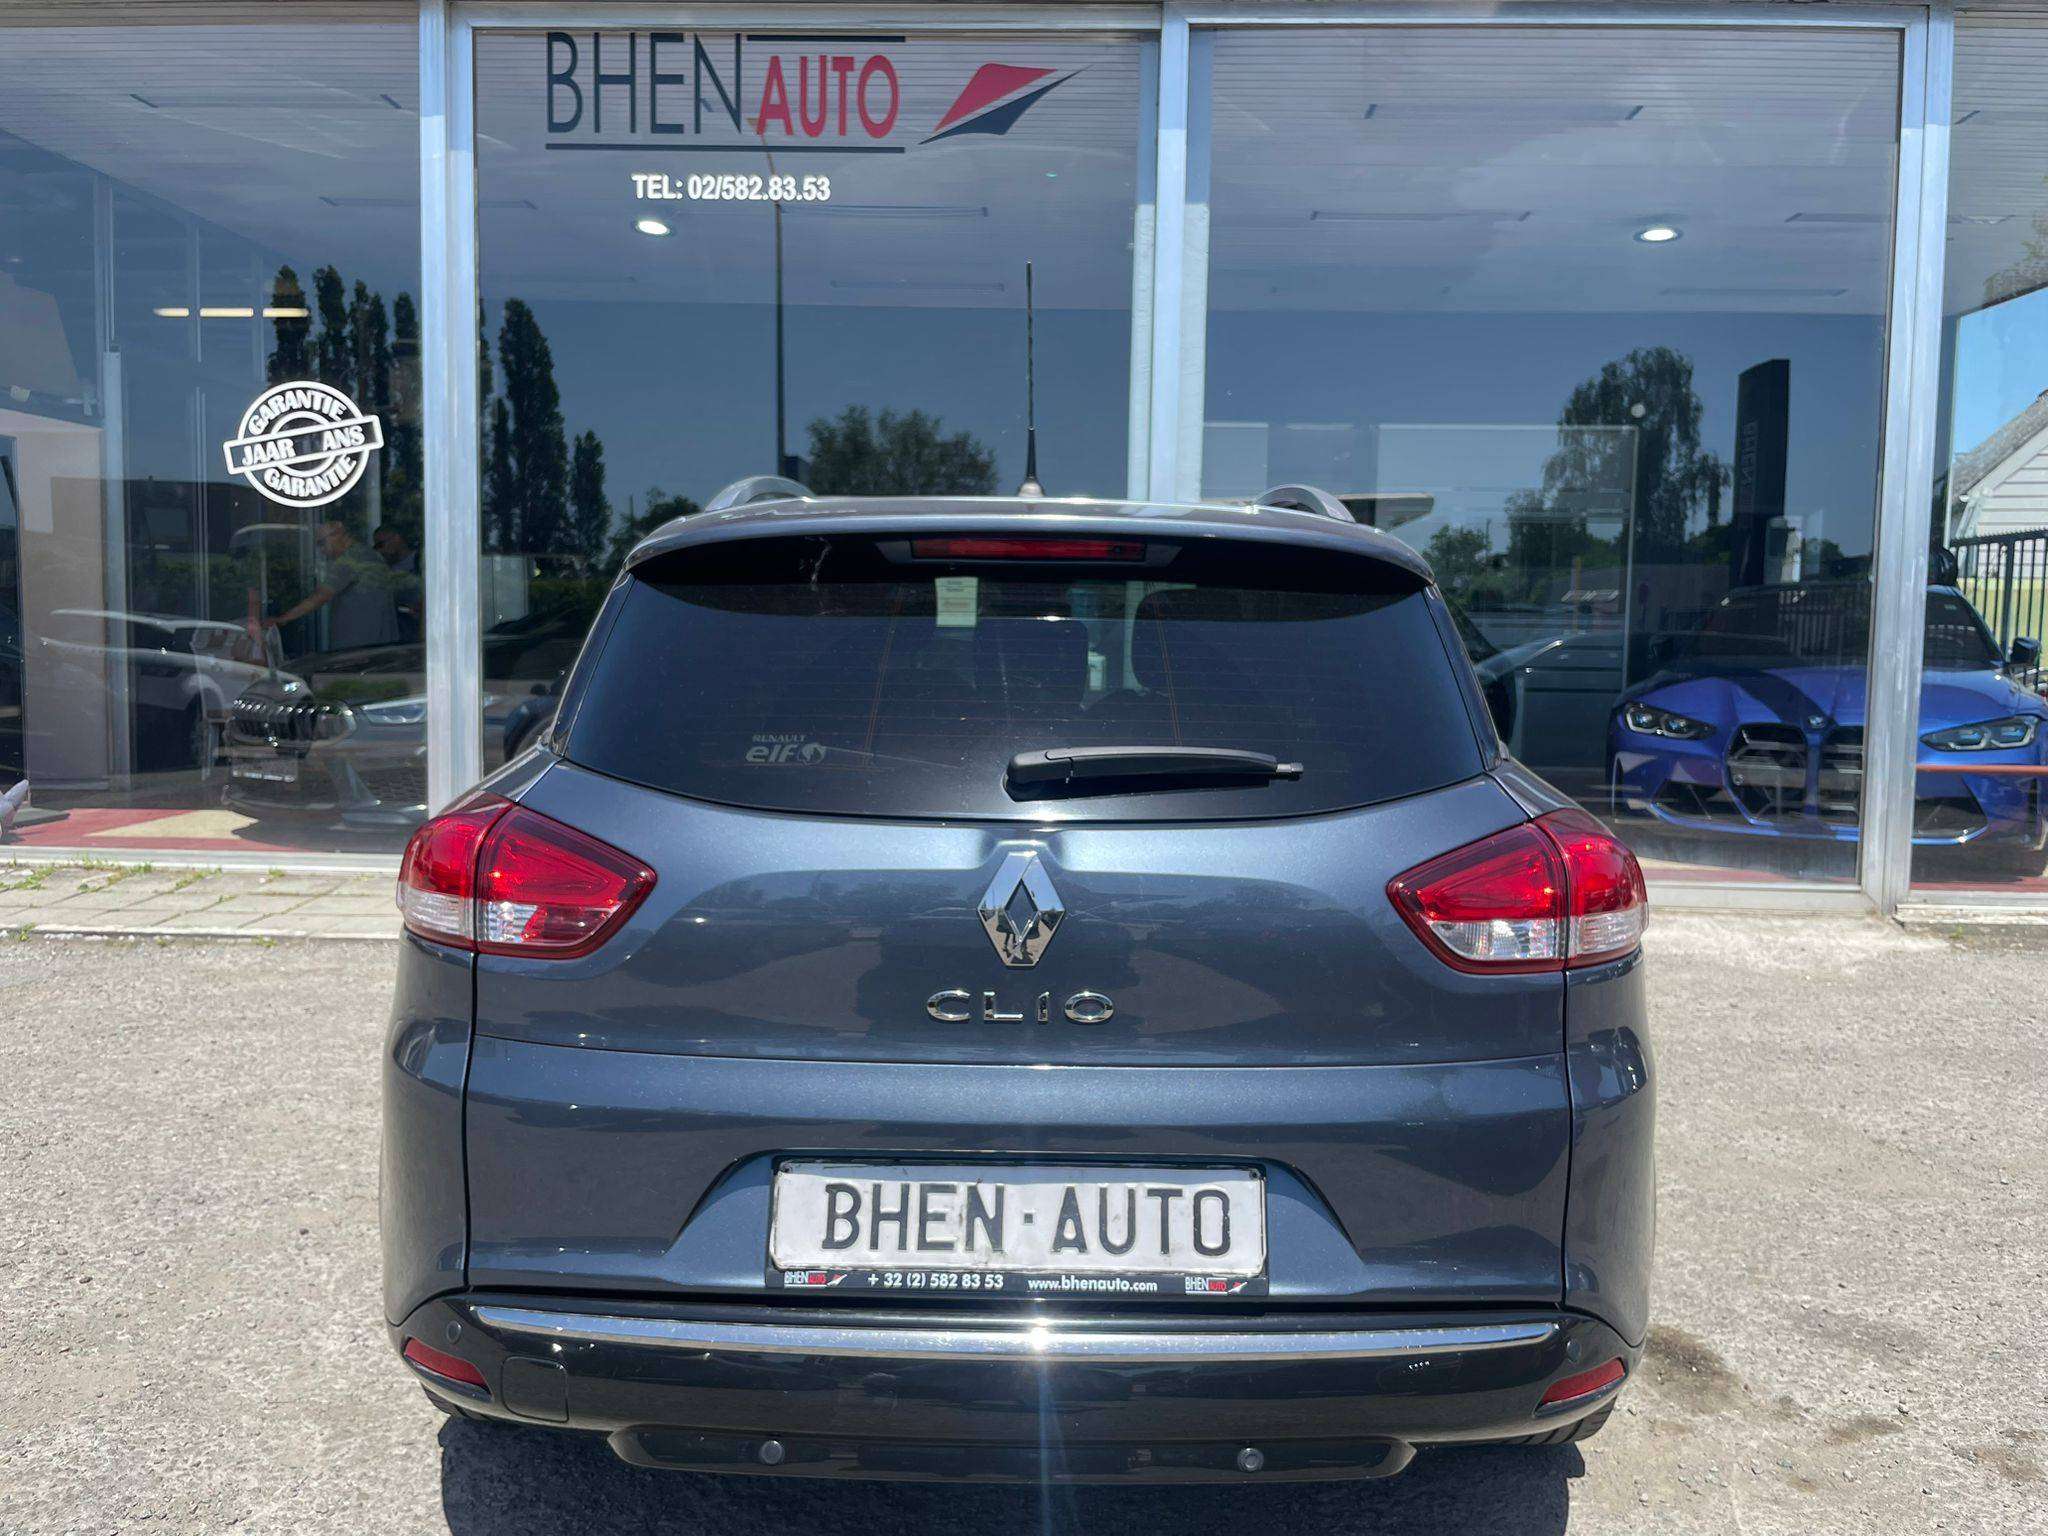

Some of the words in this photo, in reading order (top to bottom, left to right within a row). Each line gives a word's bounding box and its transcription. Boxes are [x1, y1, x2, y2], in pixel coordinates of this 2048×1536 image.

[631, 174, 683, 199] TEL:
[687, 175, 831, 200] 02/582.83.53
[248, 389, 347, 436] GARANTIE
[242, 438, 296, 465] JAAR
[323, 425, 365, 451] ANS
[264, 456, 357, 497] GARANTIE
[745, 744, 799, 762] elf
[927, 990, 1114, 1023] CLIO
[883, 1272, 903, 1288] 32
[906, 1272, 926, 1288] (2)
[929, 1273, 958, 1290] 582
[961, 1273, 981, 1290] 83
[984, 1273, 1004, 1290] 53
[1028, 1275, 1158, 1293] www.bhenauto.com
